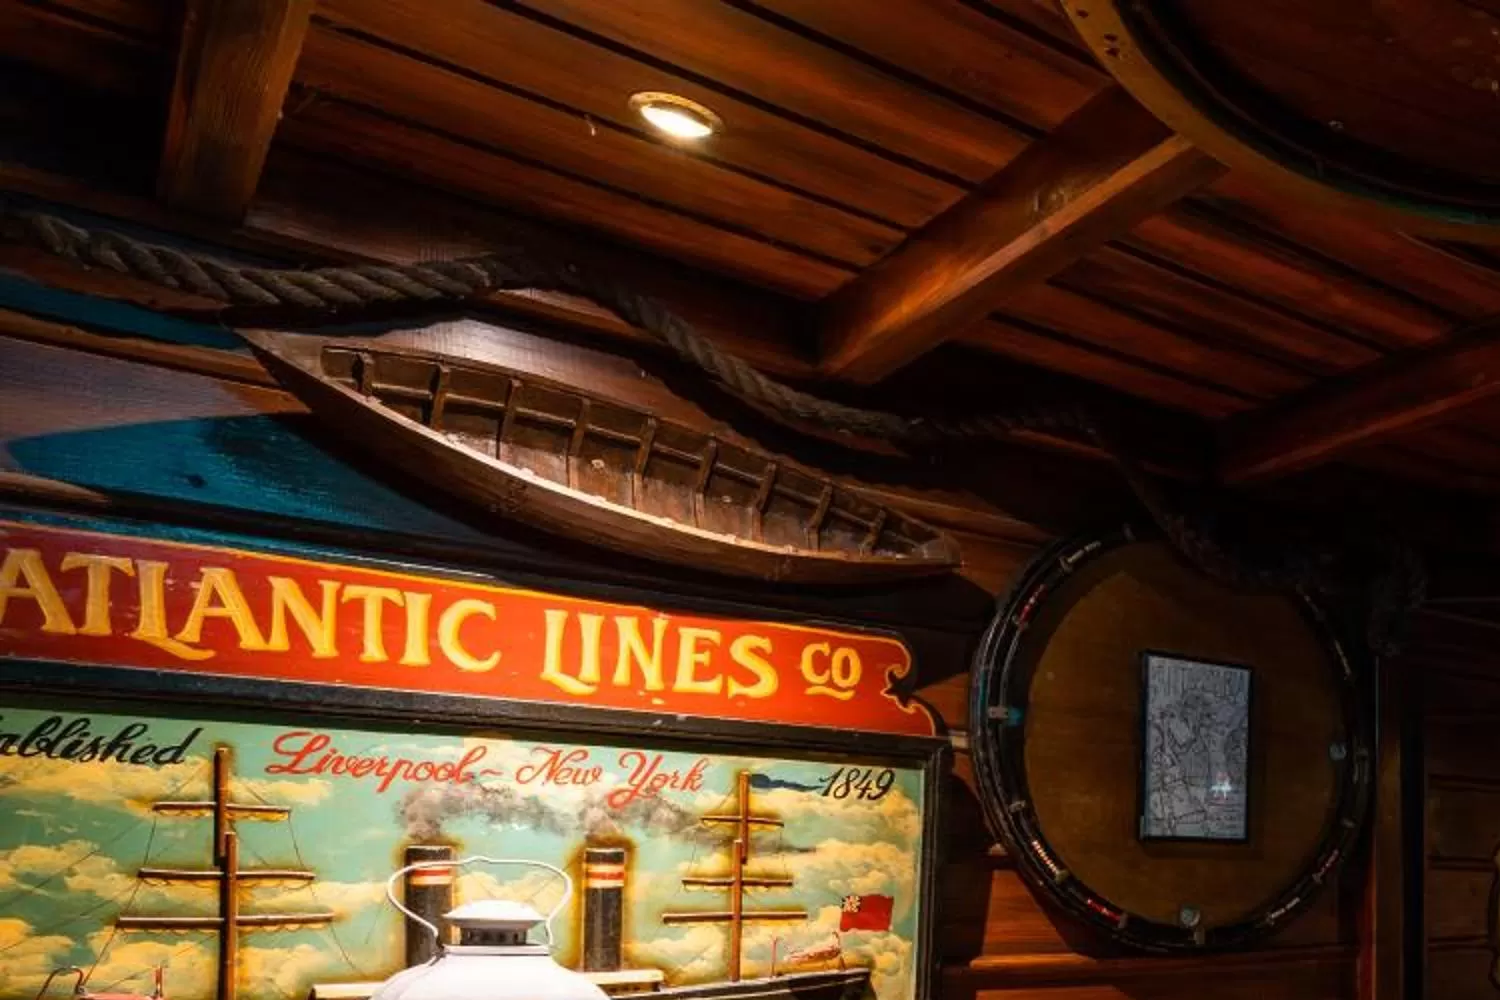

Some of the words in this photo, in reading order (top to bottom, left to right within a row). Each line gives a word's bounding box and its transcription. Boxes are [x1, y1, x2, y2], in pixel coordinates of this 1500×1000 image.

[0, 548, 502, 673] ATLANTIC
[540, 609, 780, 699] LINES
[801, 642, 862, 700] CO
[264, 731, 487, 793] Liverpool
[515, 746, 603, 785] New
[608, 751, 708, 809] York
[819, 767, 895, 801] 1849
